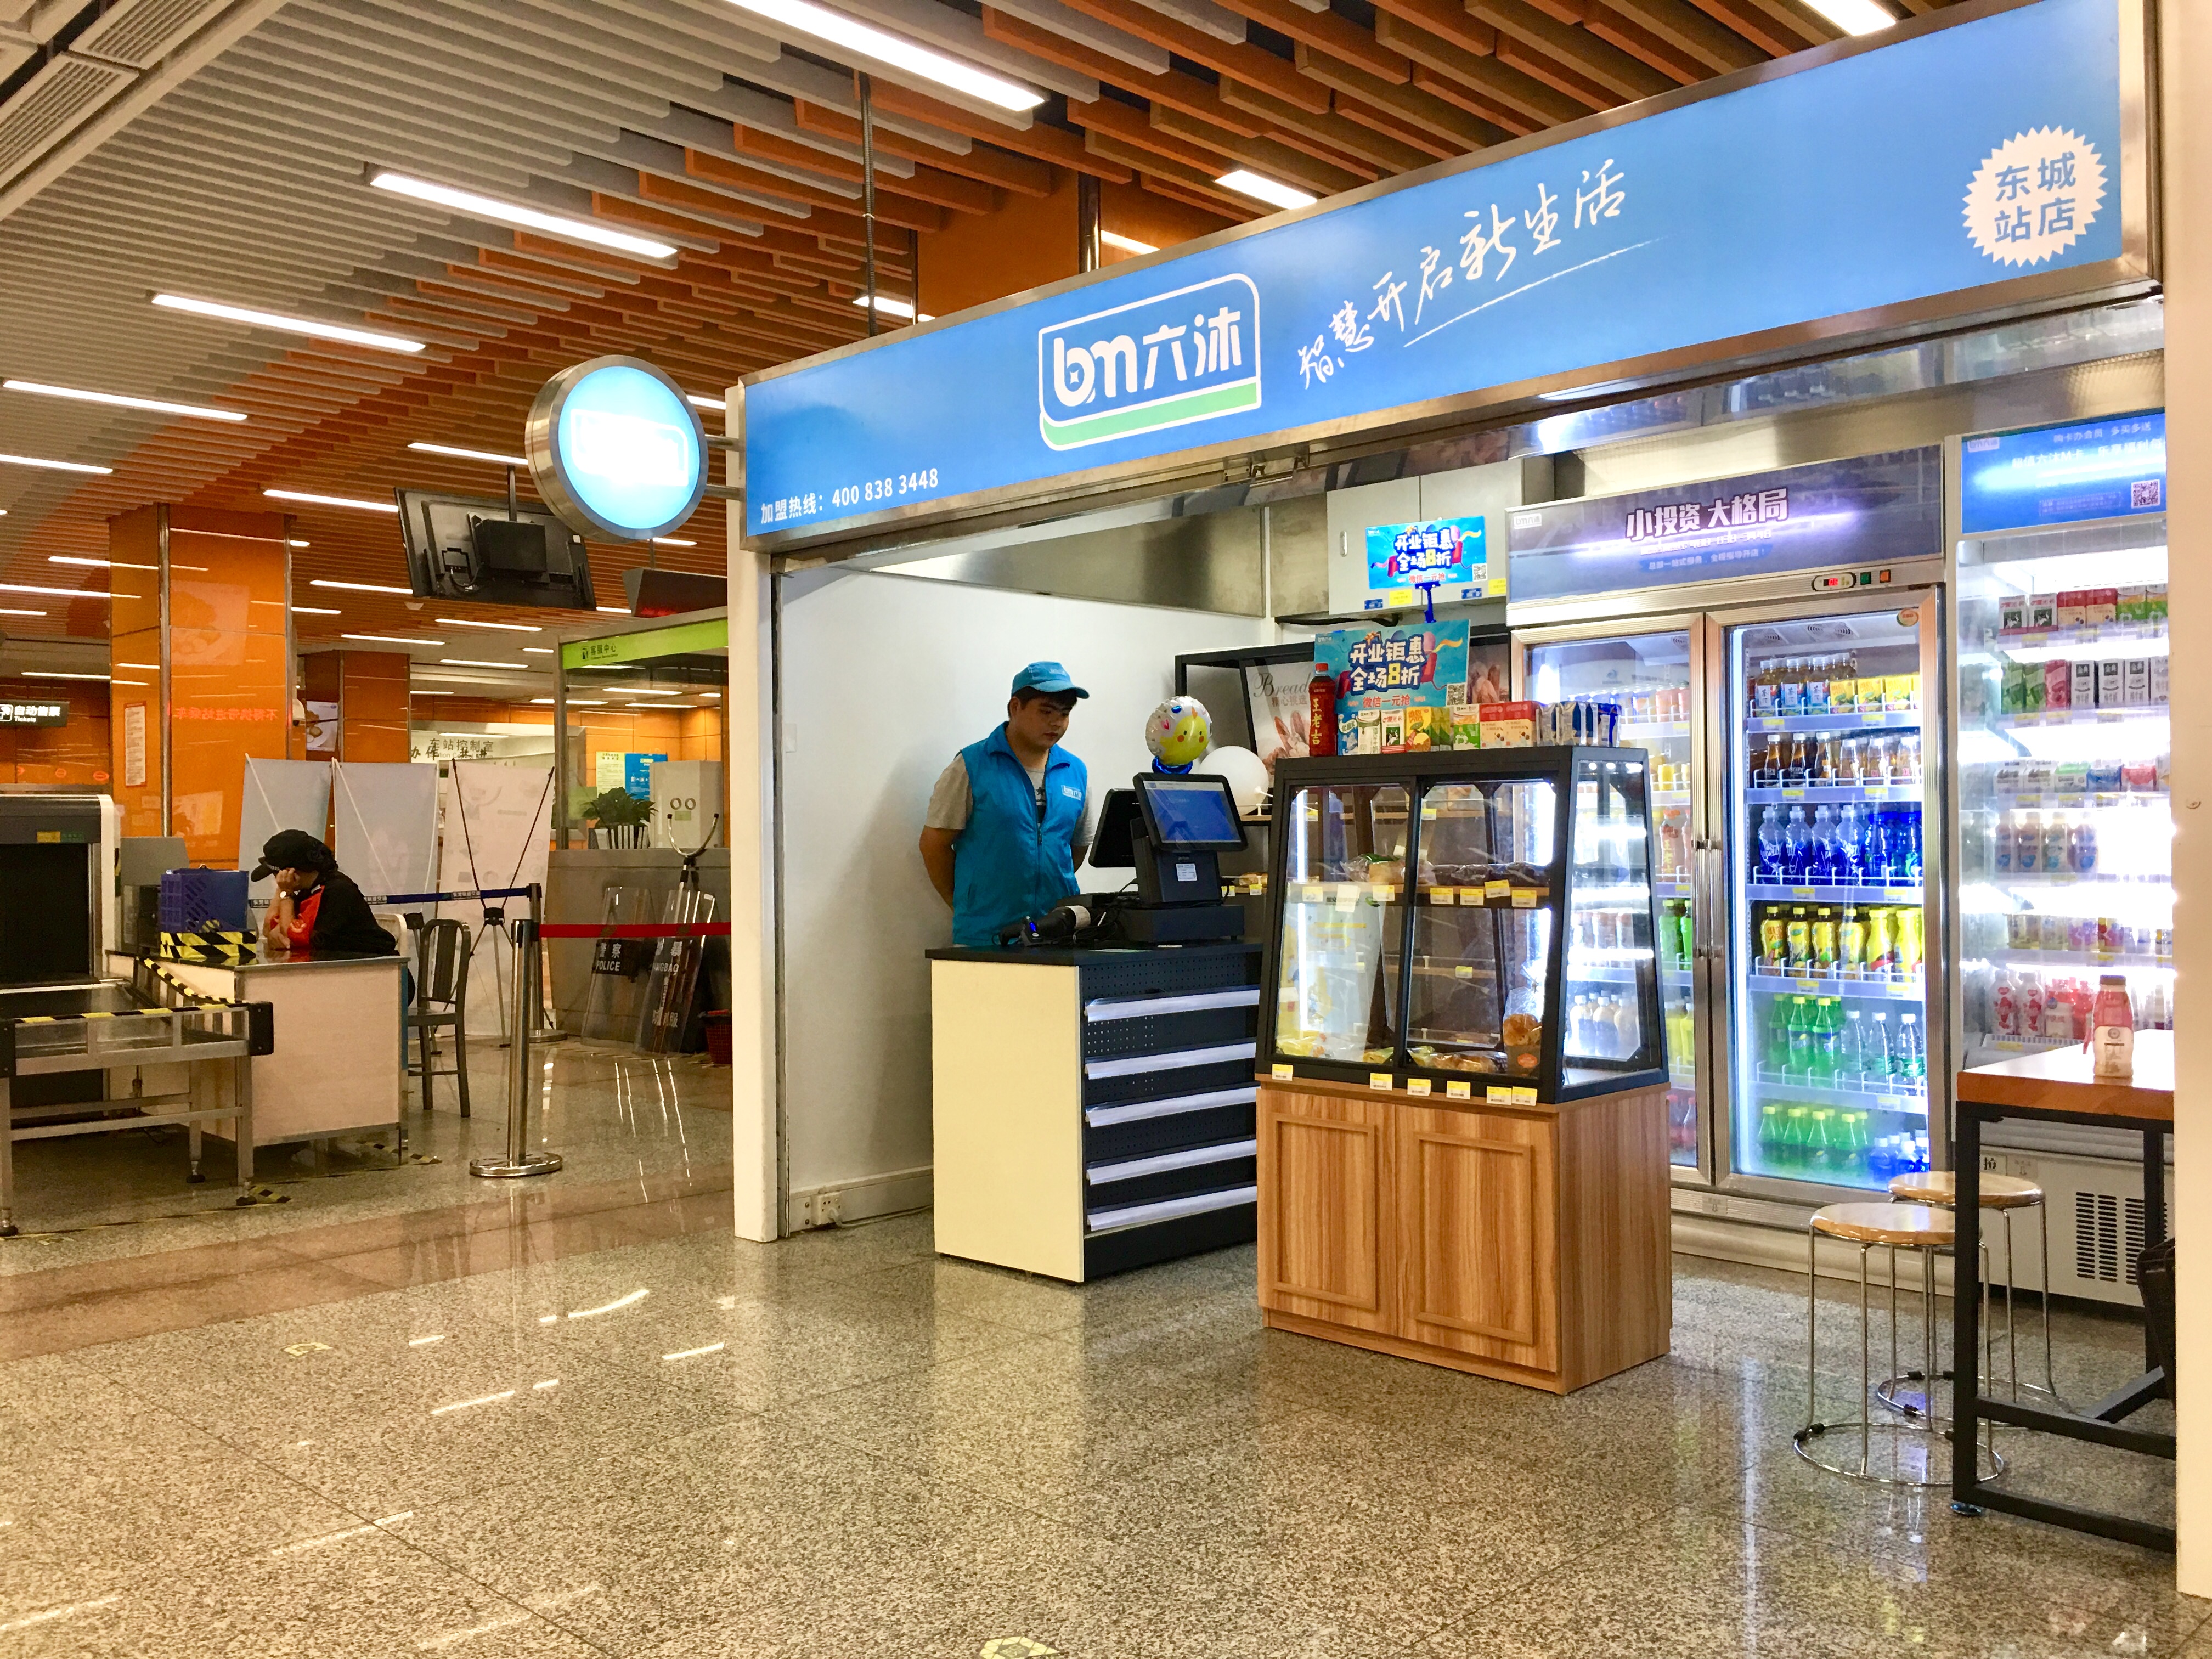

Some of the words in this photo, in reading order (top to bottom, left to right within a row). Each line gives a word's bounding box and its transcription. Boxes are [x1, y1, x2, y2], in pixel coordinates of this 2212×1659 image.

[1995, 151, 2076, 202] 东城
[1994, 196, 2076, 243] 站店
[1297, 158, 1625, 390] 智慧开启新生活
[832, 485, 859, 507] 400
[865, 478, 893, 501] 838
[899, 468, 939, 494] 3448
[1626, 503, 1700, 540] 小投资
[1707, 488, 1787, 527] 大格局
[1395, 528, 1454, 551] 开业钜惠
[1397, 549, 1451, 572] 全场8折
[1350, 635, 1426, 665] 开业钜惠
[1253, 672, 1311, 697] Bread
[1350, 663, 1420, 692] 全场8折
[1363, 694, 1410, 708] 微信一元抢
[1311, 698, 1323, 745] 王老吉
[595, 960, 621, 972] POLICE
